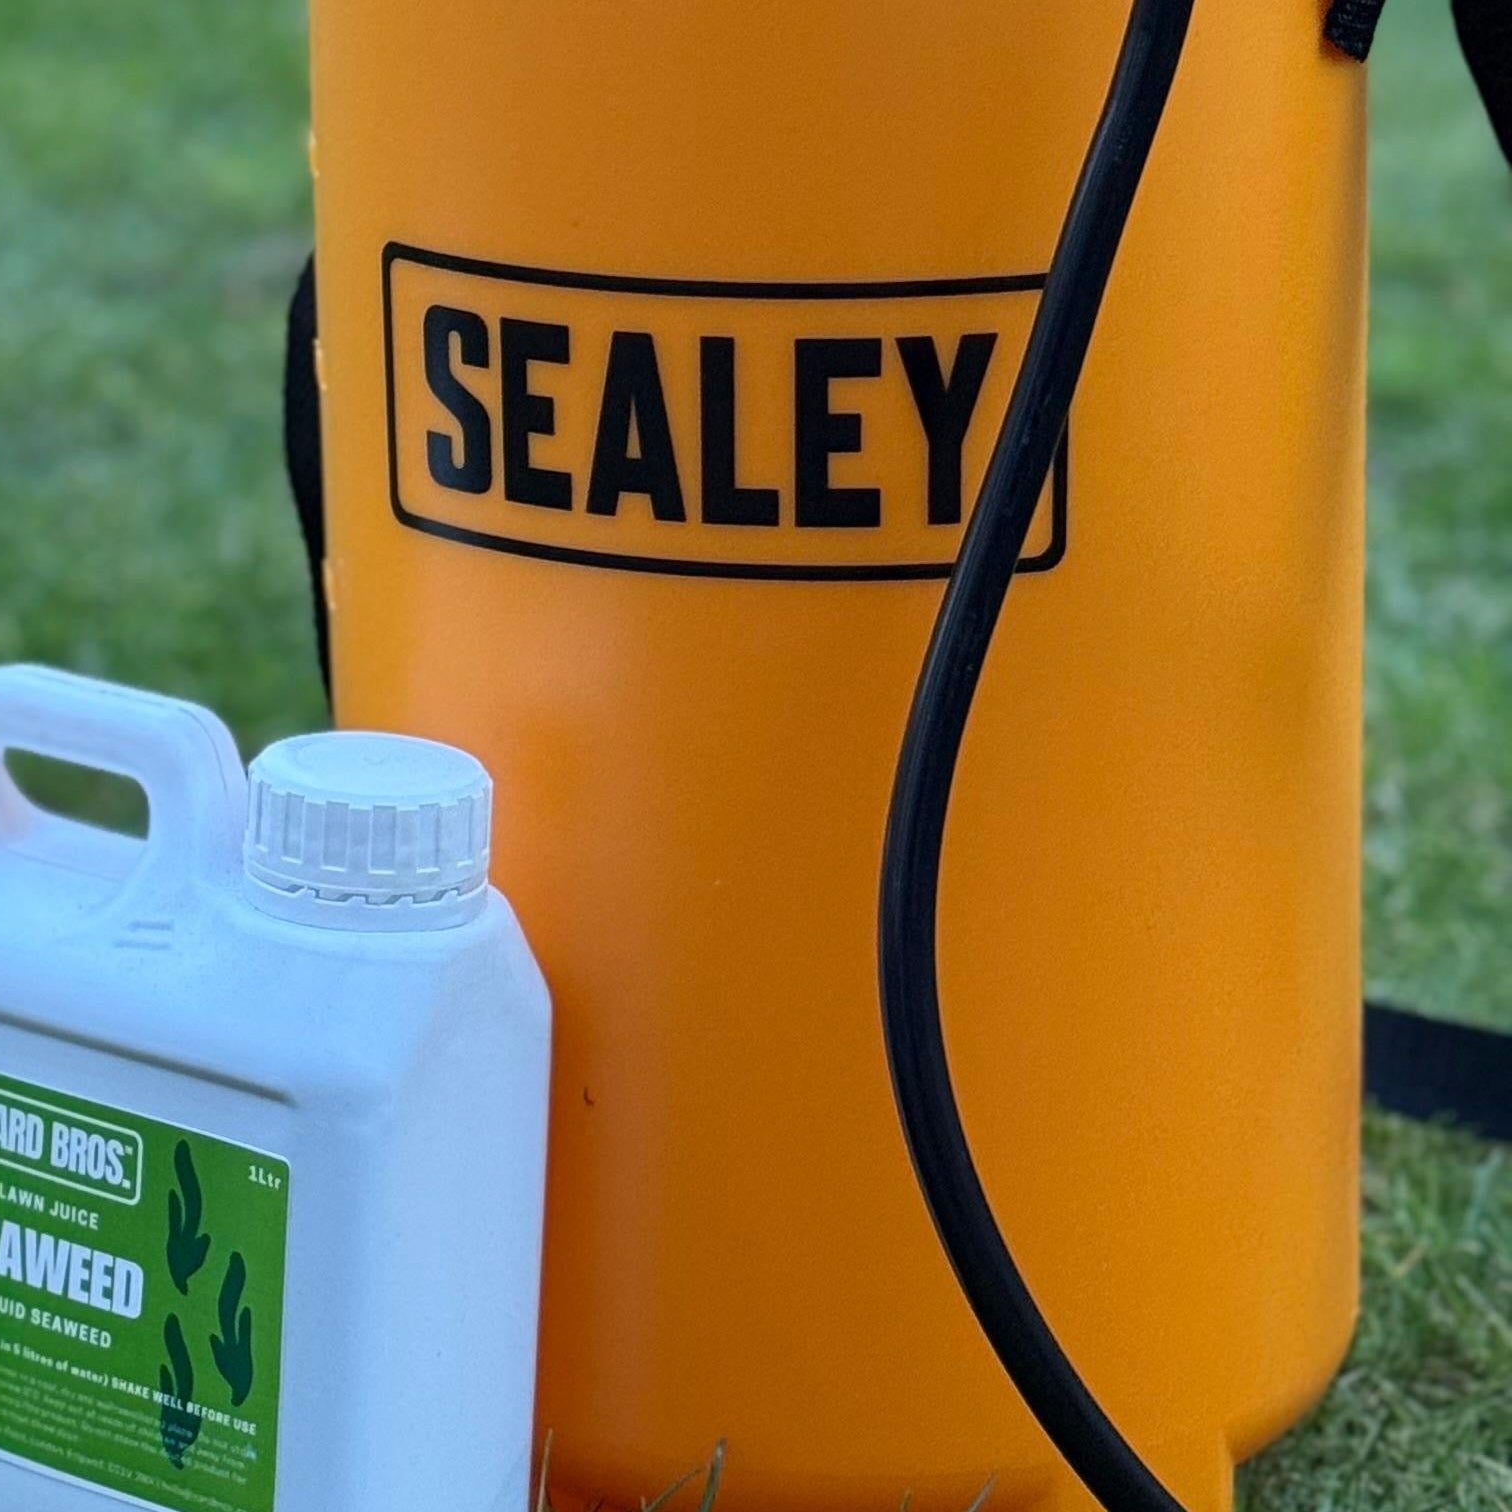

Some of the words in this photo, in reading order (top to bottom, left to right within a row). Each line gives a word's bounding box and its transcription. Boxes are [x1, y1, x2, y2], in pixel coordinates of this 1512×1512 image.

[422, 303, 999, 528] SEALEY
[248, 1165, 282, 1190] 1Ltr
[49, 1200, 100, 1230] JUICE
[30, 1308, 112, 1349] SEAWEED
[0, 1337, 11, 1352] in
[22, 1345, 54, 1368] litres
[55, 1360, 69, 1372] of
[71, 1366, 109, 1388] water)
[111, 1376, 150, 1400] SHAKE
[152, 1390, 184, 1411] WELL
[186, 1401, 231, 1427] BEFORE
[233, 1419, 257, 1436] USE
